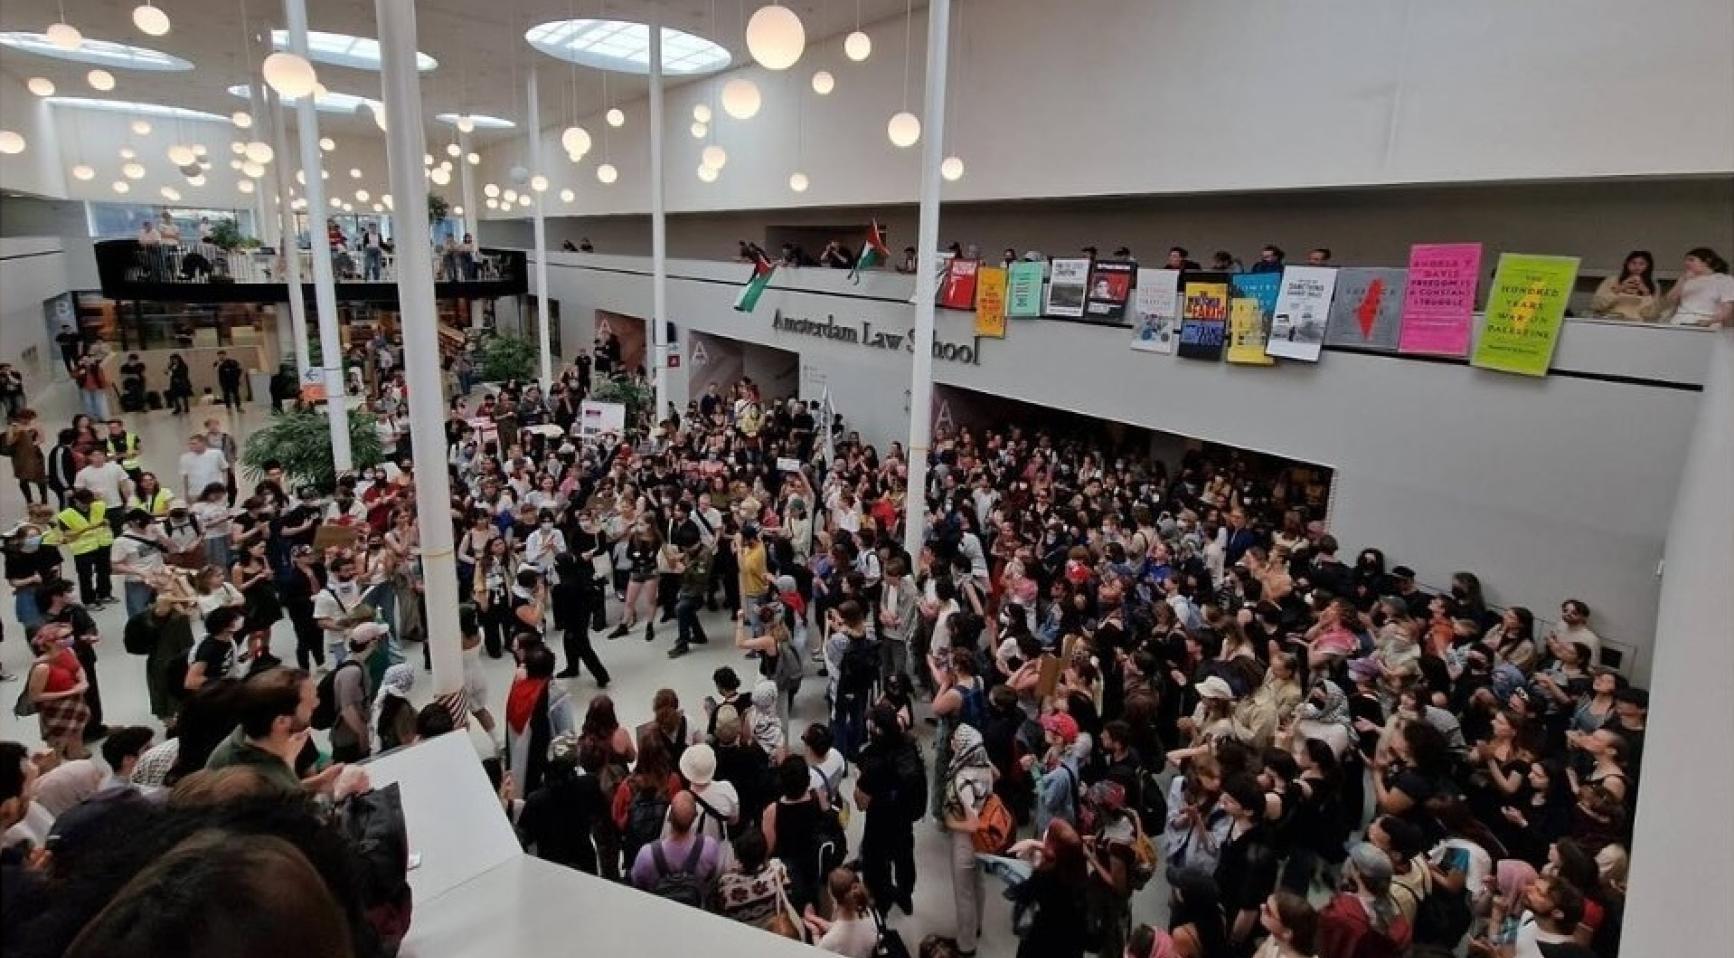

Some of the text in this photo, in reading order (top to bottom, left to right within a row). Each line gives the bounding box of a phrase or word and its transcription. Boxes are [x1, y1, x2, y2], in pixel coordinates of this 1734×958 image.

[1423, 270, 1460, 278] DAVIS
[1410, 279, 1472, 288] FREEDOM IS
[1419, 289, 1471, 297] CONSTANT
[1501, 286, 1560, 297] HUNDRED
[1413, 297, 1465, 306] STRUGGLE
[1505, 298, 1544, 310] YEARS
[1498, 312, 1525, 322] WAR
[772, 308, 858, 344] Amsterdam
[862, 321, 904, 350] Law
[1488, 324, 1550, 339] PALESTINE
[692, 340, 708, 366] A
